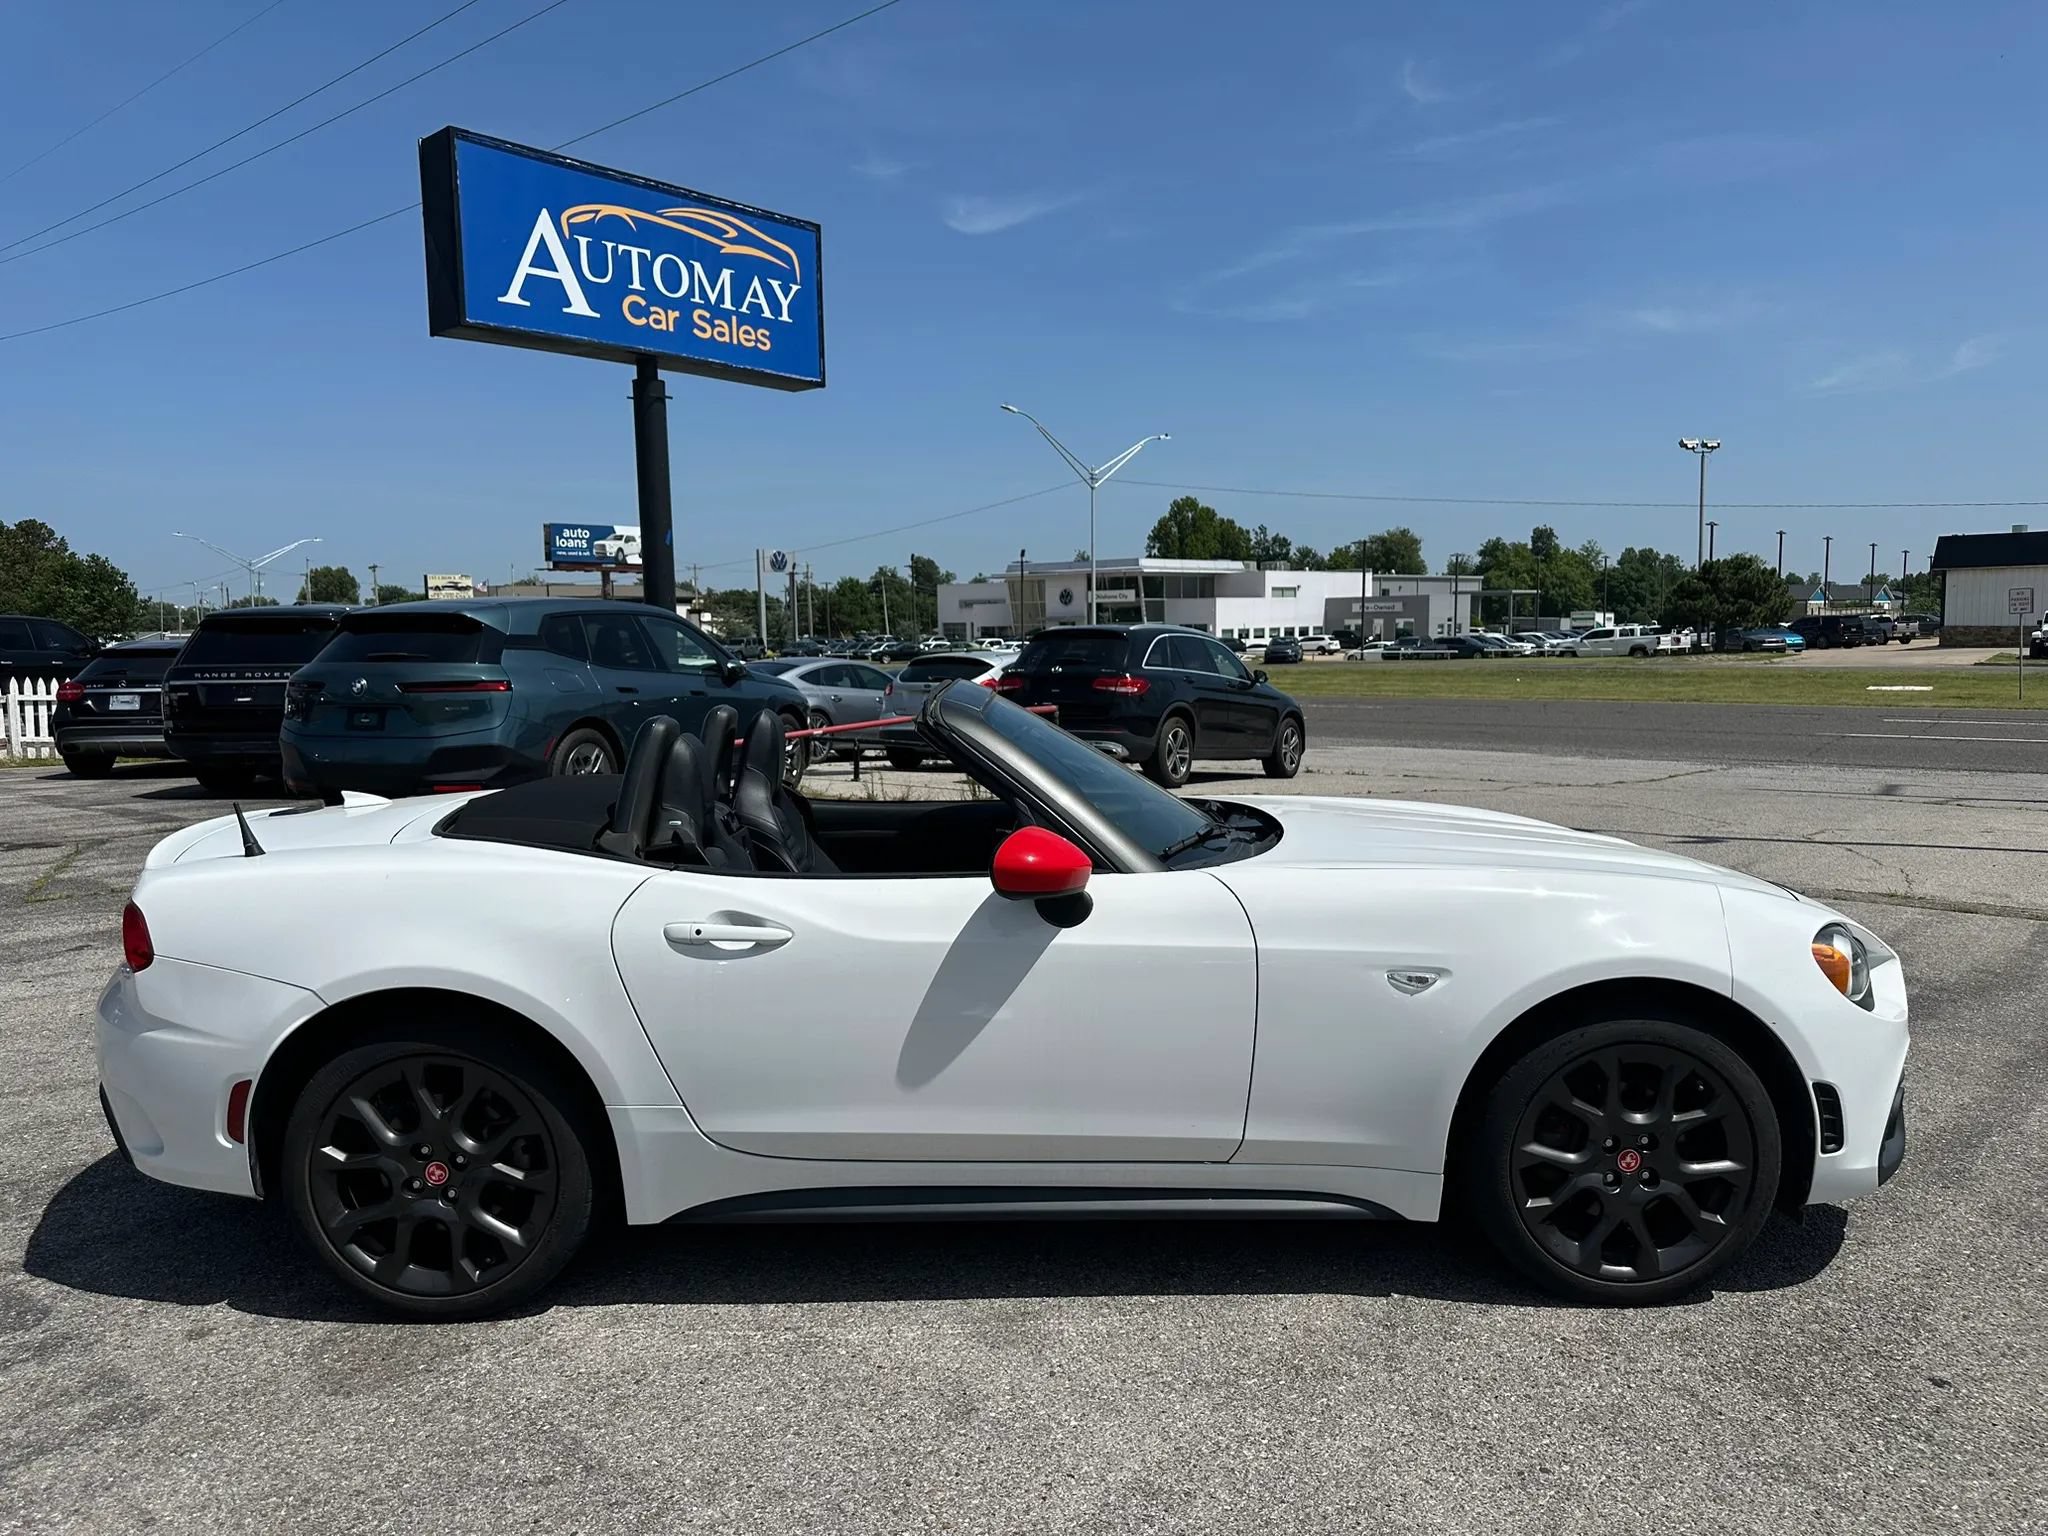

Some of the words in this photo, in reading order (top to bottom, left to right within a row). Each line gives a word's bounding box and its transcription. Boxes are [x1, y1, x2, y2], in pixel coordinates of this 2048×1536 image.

[498, 207, 801, 323] AUTOMAY
[621, 294, 680, 332] Car
[692, 308, 771, 351] Sales
[556, 536, 587, 547] loans
[562, 528, 589, 538] auto
